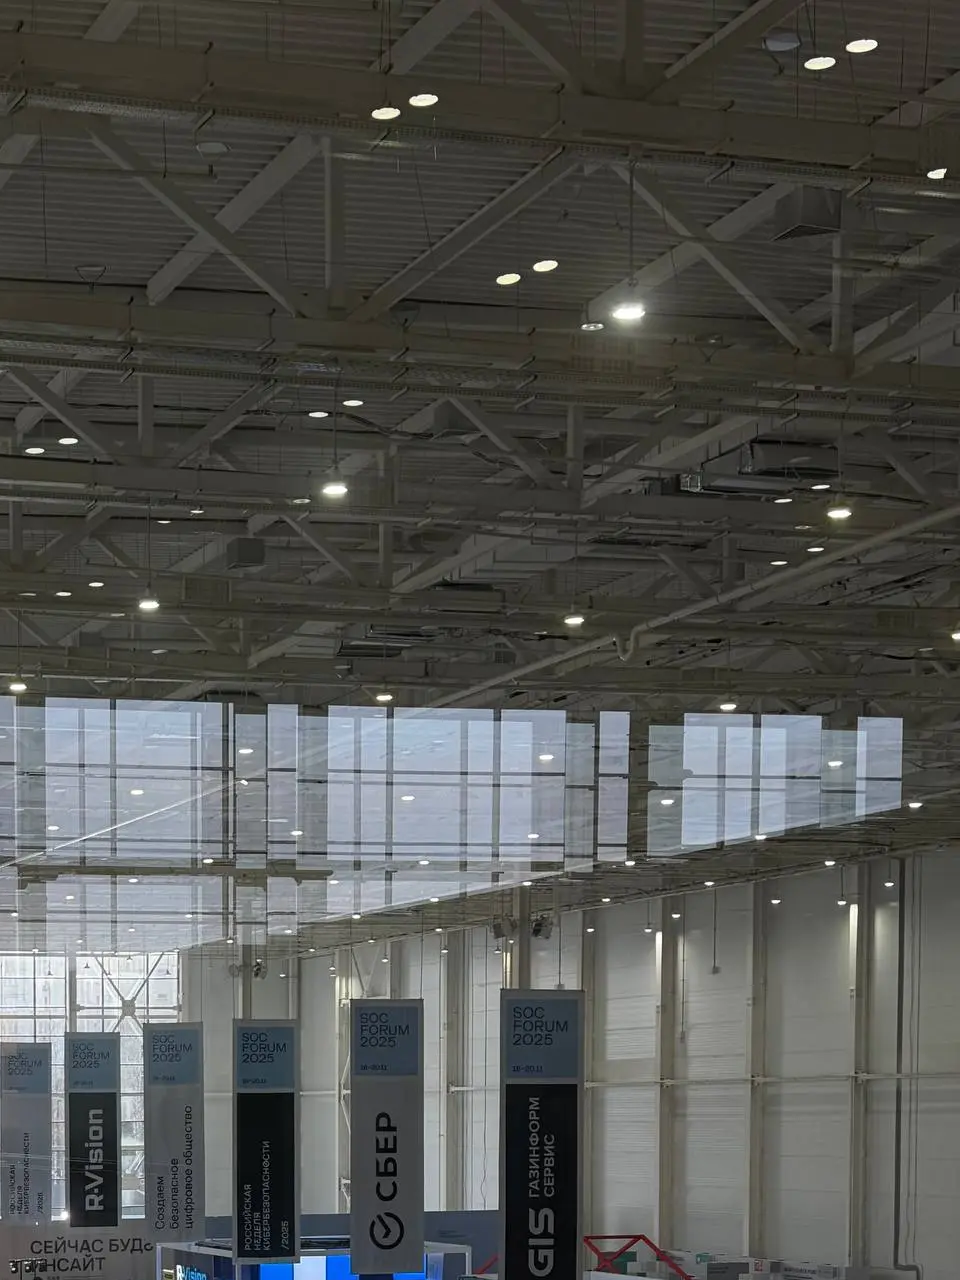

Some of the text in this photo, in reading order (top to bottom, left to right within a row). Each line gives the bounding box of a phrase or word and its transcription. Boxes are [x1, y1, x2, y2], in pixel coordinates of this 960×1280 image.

[360, 1013, 389, 1024] SOC
[513, 1006, 545, 1019] SOC
[360, 1025, 410, 1036] FORUM
[513, 1020, 568, 1033] FORUM
[152, 1035, 175, 1044] SOC
[242, 1032, 268, 1043] SOC
[360, 1036, 396, 1048] 2025
[513, 1033, 553, 1046] 2025
[72, 1043, 94, 1051] SOC
[152, 1044, 192, 1053] FORUM
[242, 1043, 287, 1053] FORUM
[72, 1050, 110, 1060] FORUM
[152, 1053, 181, 1063] 2025
[242, 1053, 274, 1064] 2025
[72, 1060, 100, 1069] 2025
[529, 1096, 540, 1198] ГАЗИНФОРМ
[375, 1111, 398, 1202] СБЕР
[183, 1105, 193, 1230] цифровое общество
[544, 1134, 555, 1198] СЕРВИС
[170, 1158, 179, 1230] безопасное
[155, 1174, 165, 1230] Создаем
[244, 1183, 252, 1251] РОССИЙСКАЯ
[31, 1236, 103, 1254] СЕЙЧАС
[528, 1208, 555, 1278] GIS
[32, 1254, 105, 1272] НСАЙТ
